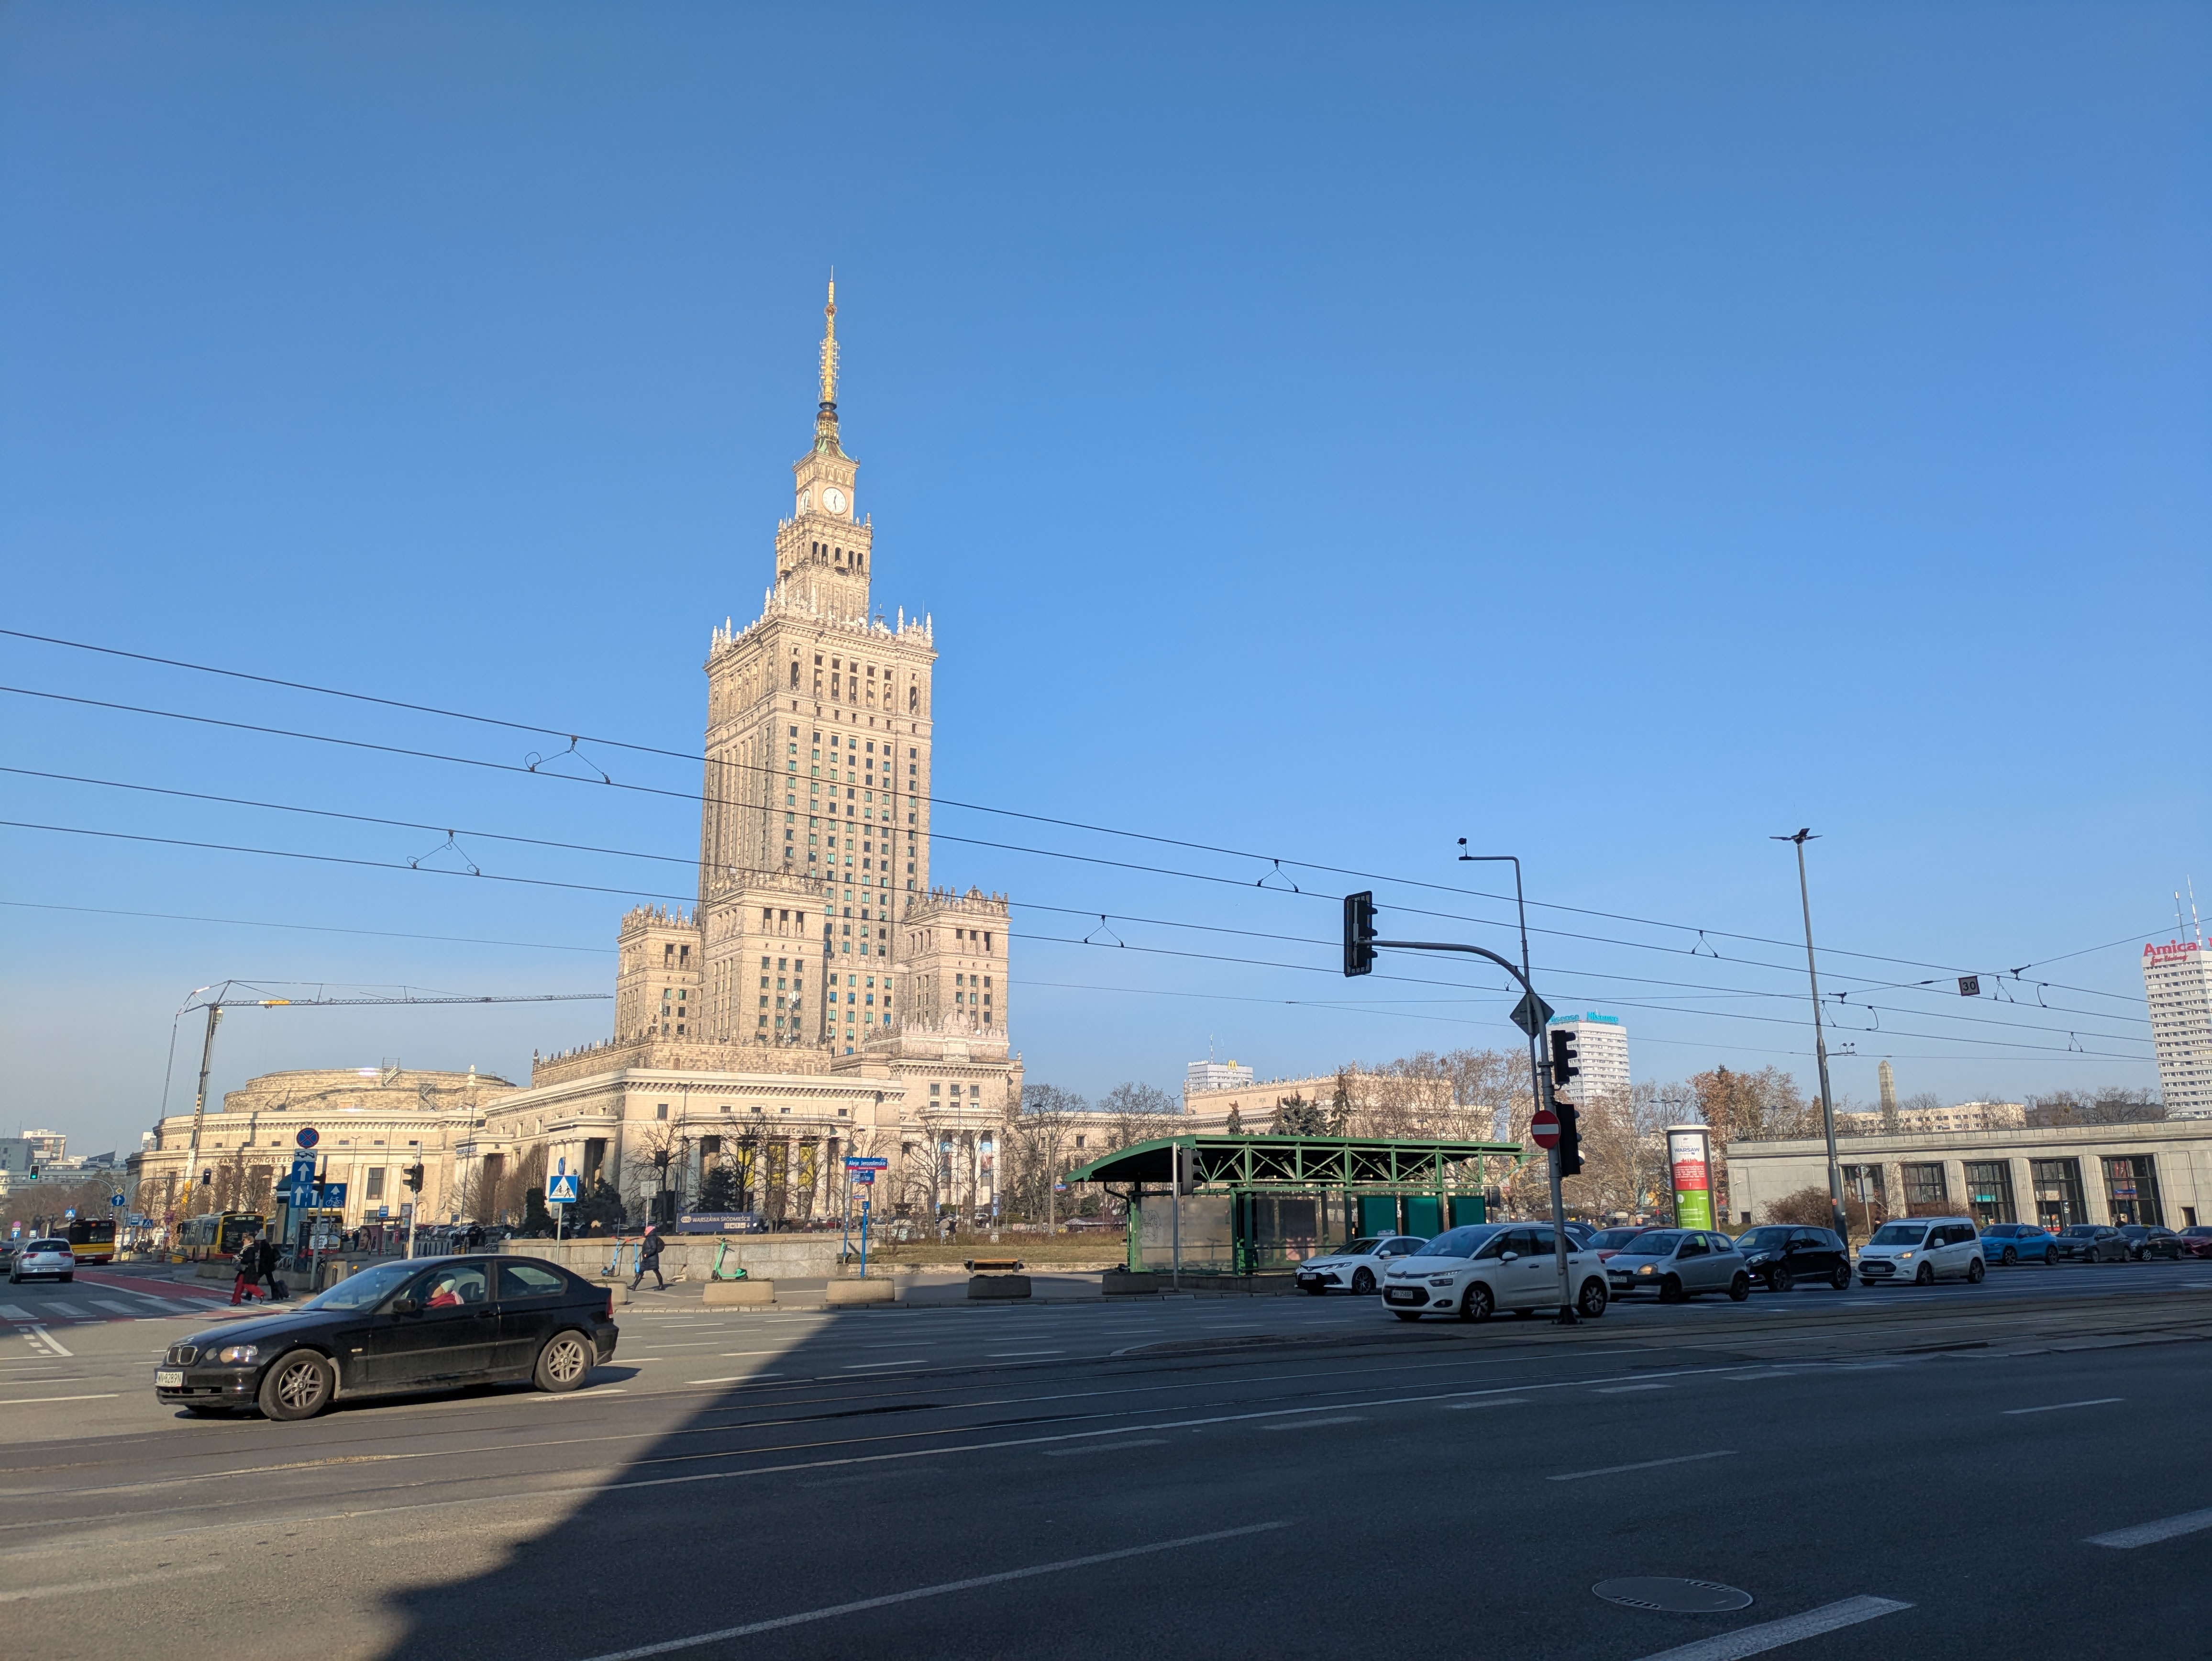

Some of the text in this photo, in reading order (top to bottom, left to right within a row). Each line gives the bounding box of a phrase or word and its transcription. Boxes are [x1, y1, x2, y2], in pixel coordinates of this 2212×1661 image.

[2144, 940, 2197, 956] Amica
[1962, 981, 1976, 991] 30
[1549, 1014, 1580, 1023] isense
[1587, 1011, 1619, 1023] Hisense
[158, 1373, 182, 1384] WN 8289N
